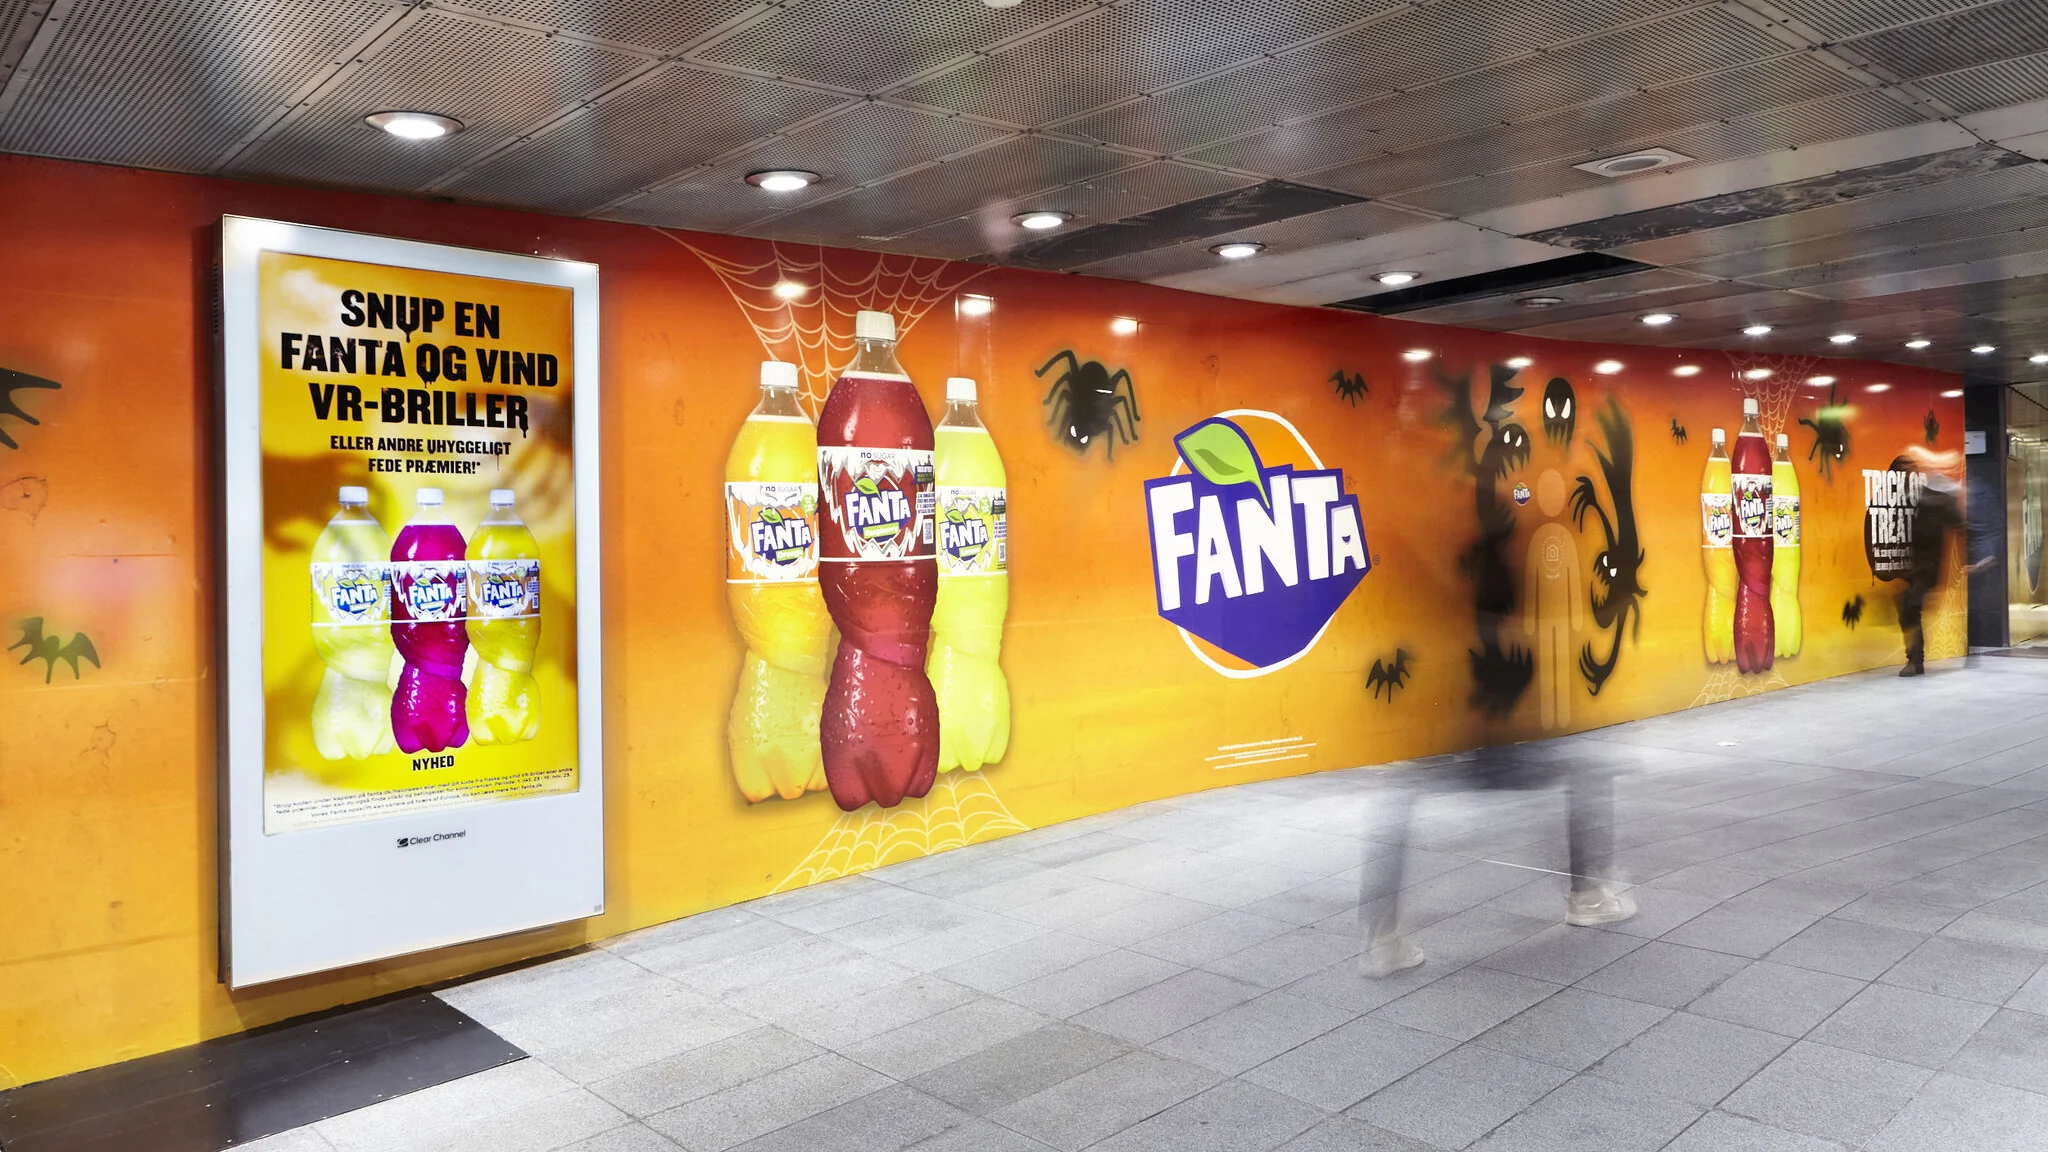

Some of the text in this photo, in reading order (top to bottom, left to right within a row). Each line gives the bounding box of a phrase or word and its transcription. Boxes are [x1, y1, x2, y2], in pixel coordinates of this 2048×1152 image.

[340, 289, 500, 341] SNUP EN
[281, 332, 558, 387] FANTA OG VIND
[309, 383, 528, 431] VR-BRILLER
[330, 435, 511, 455] ELLER ANDRE UHYGGELIGT
[368, 458, 402, 472] FEDE
[1862, 469, 1907, 508] TRICK
[845, 491, 912, 527] FANTA
[751, 519, 812, 552] FANTA
[940, 519, 989, 549] FANTA
[1150, 474, 1367, 611] FANTA
[331, 584, 378, 607] FANTA
[408, 583, 454, 605] FANTA
[482, 581, 523, 601] FANTA
[412, 755, 455, 771] NYHED
[410, 829, 466, 845] Clear Channel
